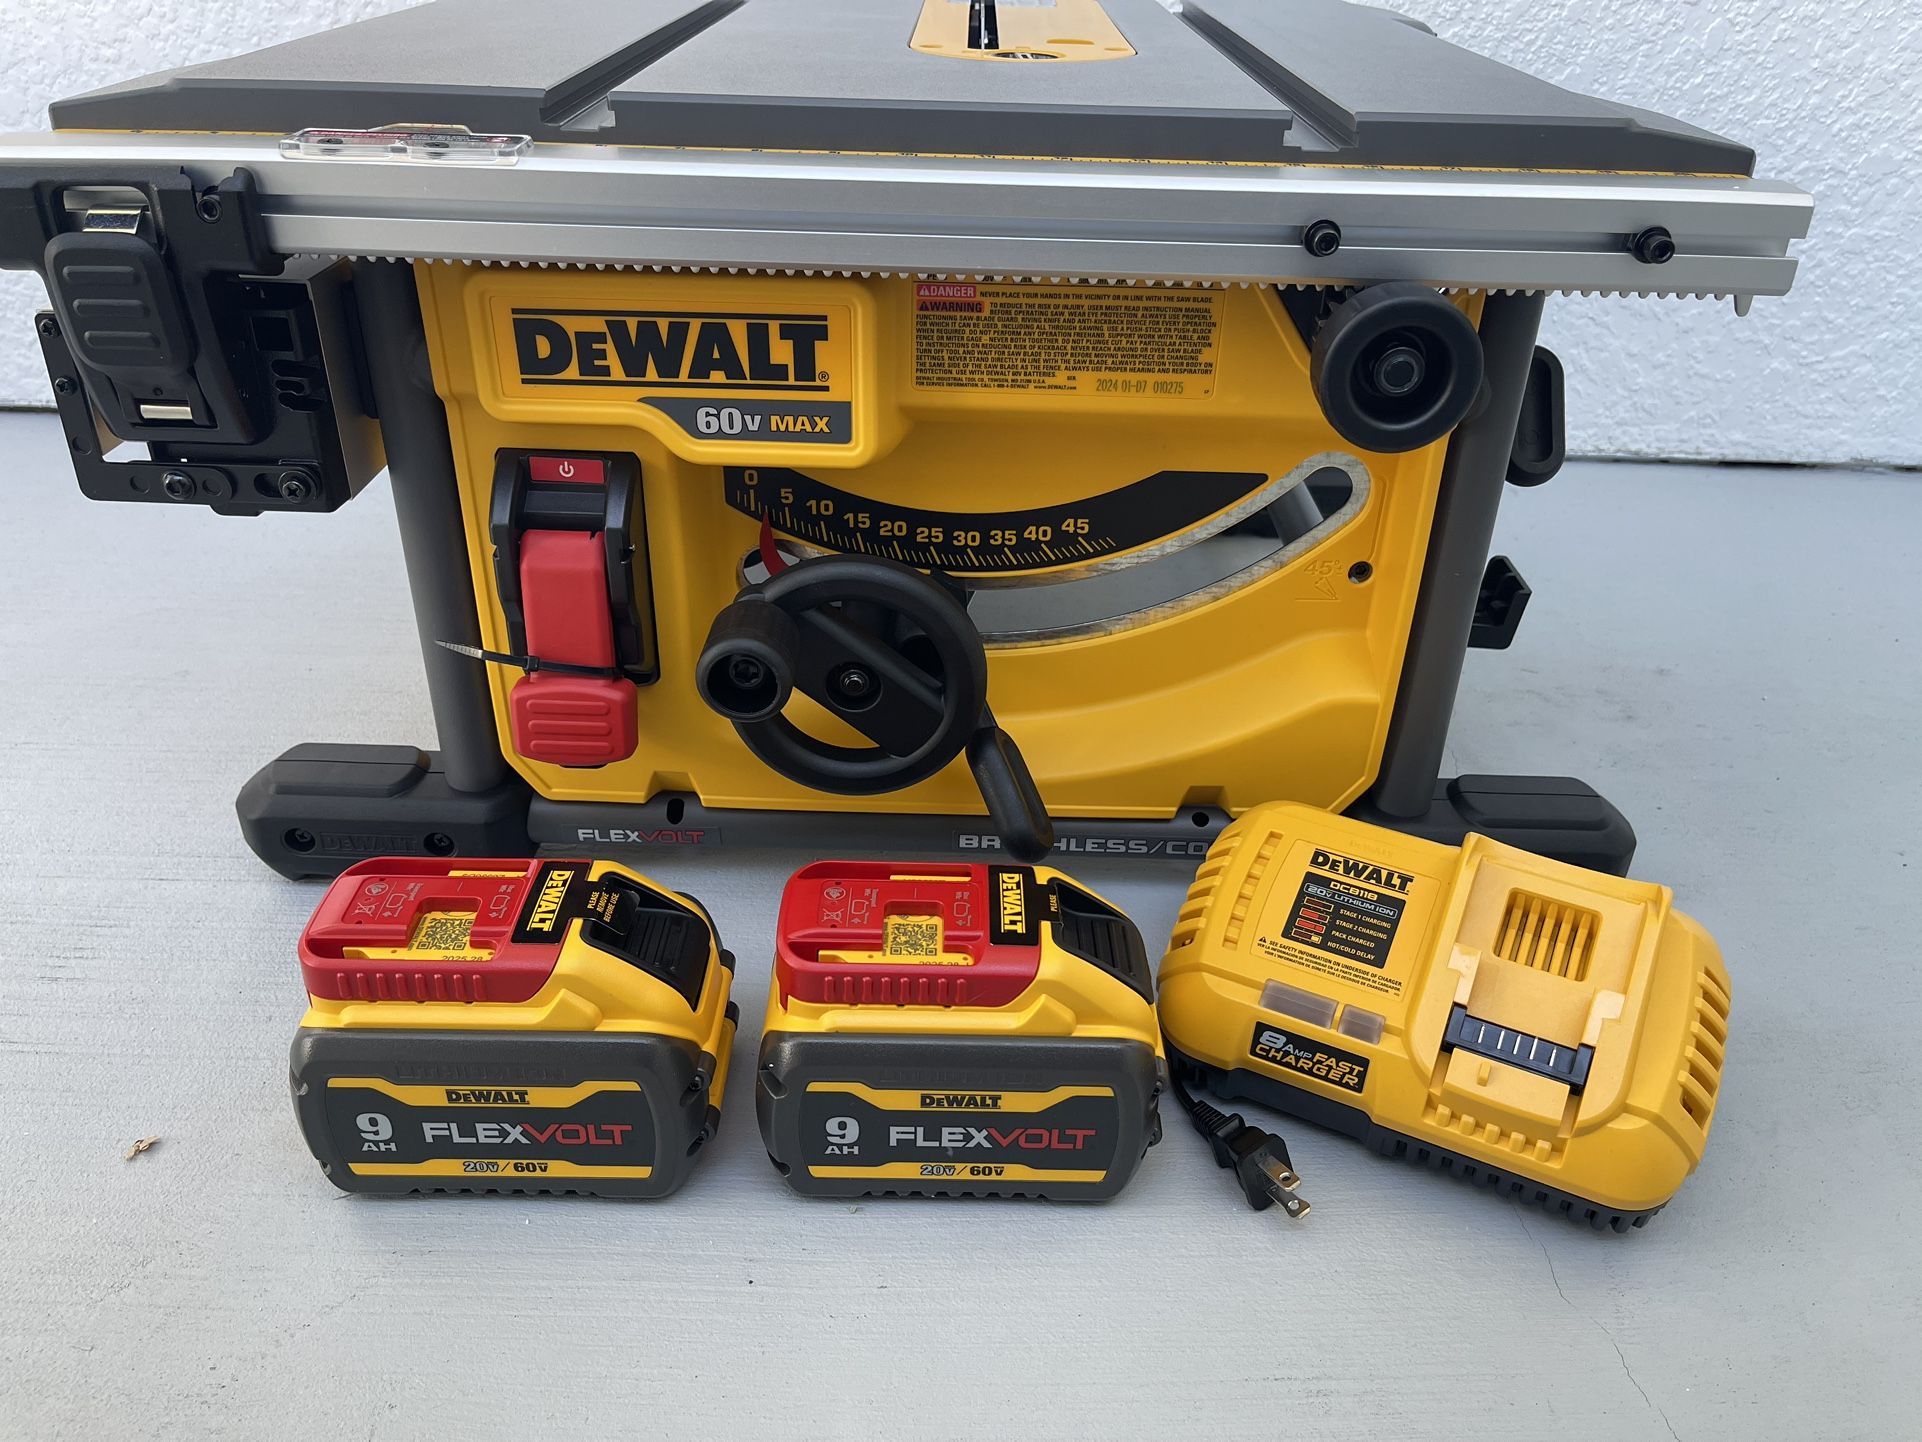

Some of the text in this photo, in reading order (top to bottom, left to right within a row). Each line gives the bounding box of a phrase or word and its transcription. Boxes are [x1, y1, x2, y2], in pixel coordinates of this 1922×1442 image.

[931, 286, 974, 297] DANGER
[930, 302, 982, 312] WARNING
[1096, 379, 1117, 392] 2024
[1153, 381, 1183, 394] 010275
[770, 416, 830, 433] MAX
[744, 470, 1090, 546] 0 5 10 15 20 25 30 35 40 45
[578, 828, 704, 844] FLEXVOLT
[1310, 851, 1413, 893] DEWALT
[587, 891, 599, 909] PLEASE
[1330, 882, 1378, 900] DCB118
[529, 870, 568, 932] DEWALT
[597, 892, 609, 913] REMOVE
[603, 893, 619, 922] BEFORE USE
[1002, 872, 1023, 934] DEWALT
[1049, 894, 1058, 912] PLEASE
[1335, 894, 1374, 910] LITHIUM
[1376, 906, 1393, 916] ION
[1340, 909, 1357, 918] STAGE
[1362, 916, 1391, 928] CHARGING
[1332, 931, 1374, 947] PACK CHARGED
[1336, 920, 1354, 929] STAGE
[1358, 927, 1388, 939] CHARGING
[1280, 944, 1297, 953] SAFETY
[1298, 950, 1331, 964] INFORMATION
[1341, 964, 1369, 976] UNDERSIDE
[1328, 941, 1375, 960] HOT/COLD DELAY
[1259, 1030, 1363, 1076] 8 AMP FAST
[1256, 1044, 1359, 1087] CHARGER
[446, 1089, 529, 1104] DEWALT
[920, 1094, 1001, 1109] DEWALT
[356, 1113, 393, 1141] 9
[422, 1122, 632, 1145] FLEXVOLT
[824, 1117, 860, 1143] 9
[361, 1142, 397, 1152] AH
[889, 1126, 1096, 1150] FLEXVOLT
[824, 1145, 859, 1155] AH
